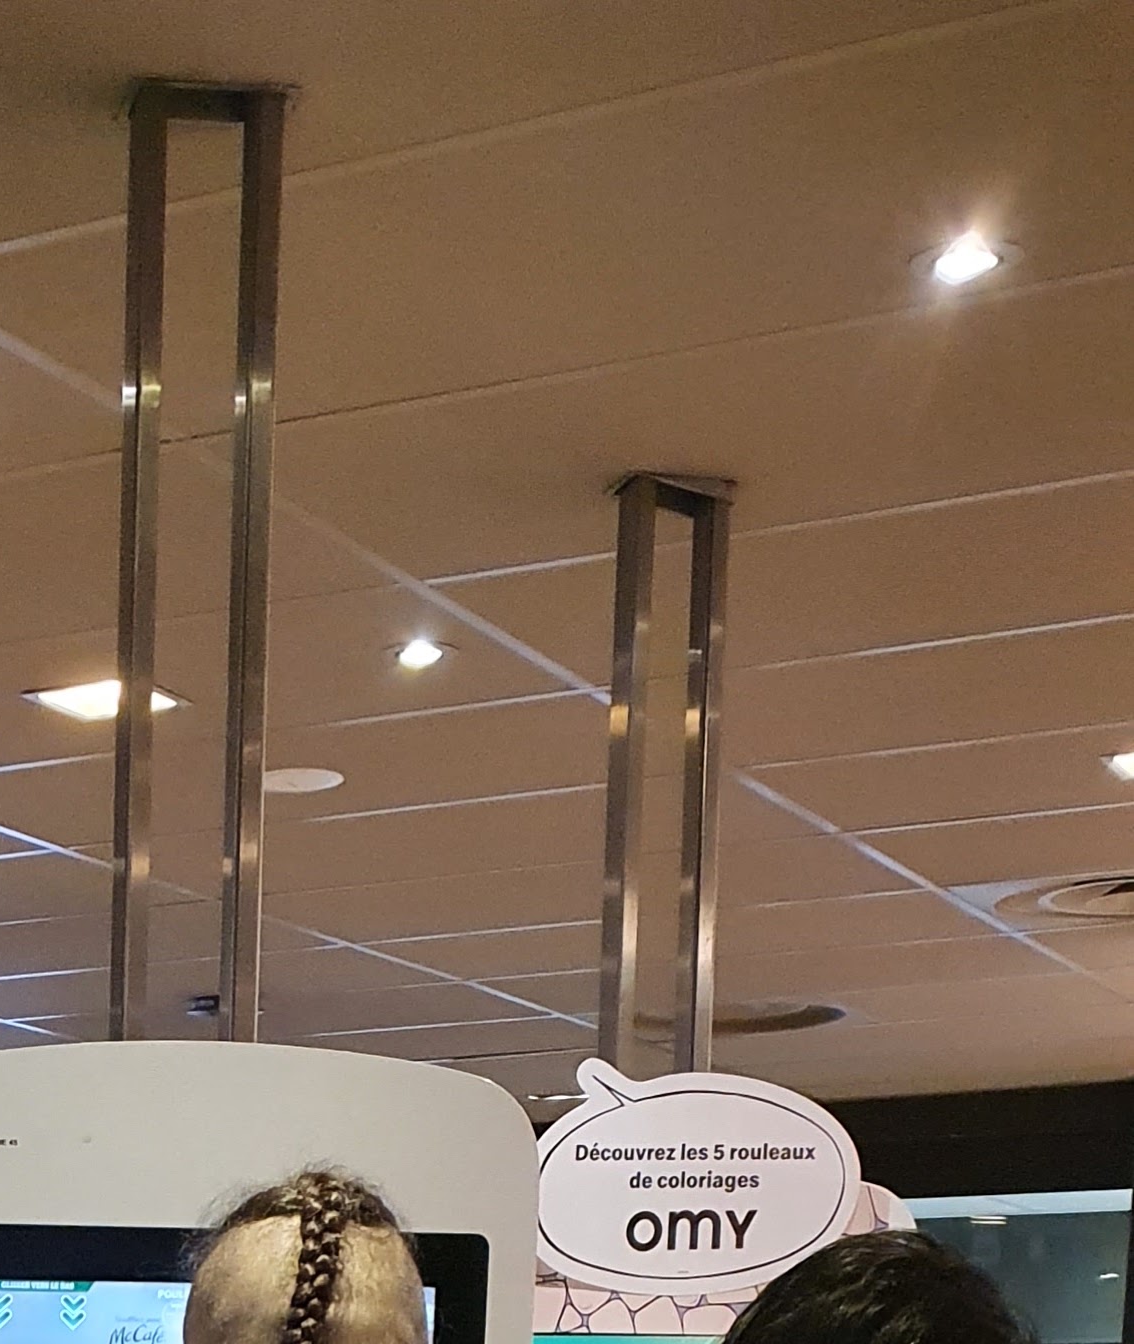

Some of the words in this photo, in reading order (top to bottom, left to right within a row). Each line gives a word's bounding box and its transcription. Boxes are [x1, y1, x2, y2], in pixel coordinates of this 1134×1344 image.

[575, 1143, 676, 1161] Découvrez
[680, 1143, 708, 1161] les
[713, 1144, 725, 1160] 5
[729, 1143, 816, 1160] rouleaux
[629, 1171, 653, 1188] de
[657, 1170, 760, 1193] coloriages
